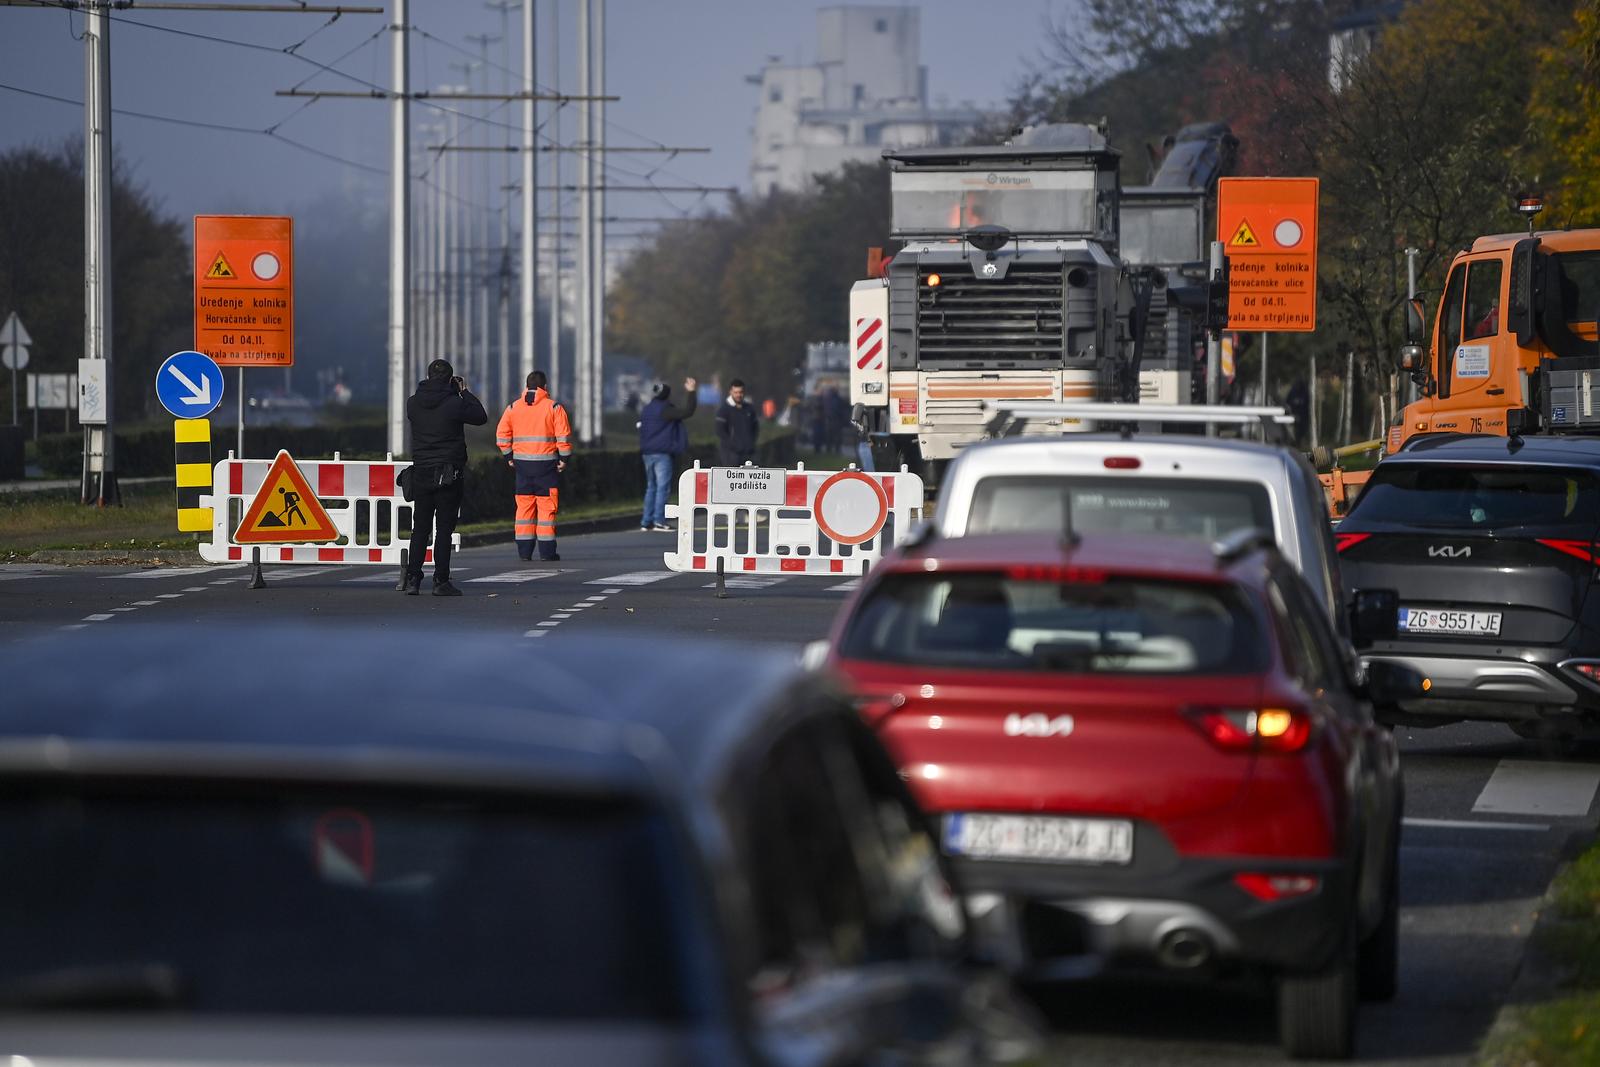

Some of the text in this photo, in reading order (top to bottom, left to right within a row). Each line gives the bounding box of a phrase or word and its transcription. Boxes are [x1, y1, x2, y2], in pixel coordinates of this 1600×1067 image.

[1275, 262, 1309, 272] kolnika
[1285, 278, 1304, 287] ulice
[253, 297, 287, 308] kolnika
[1244, 296, 1287, 306] Od 04.11.
[262, 315, 282, 324] ulice
[1264, 312, 1310, 324] strpljenju
[222, 335, 265, 345] Od 04.11.
[230, 351, 240, 359] na
[243, 350, 285, 361] strpljenju
[1470, 417, 1482, 433] 715
[726, 469, 771, 480] Osim vozila
[1428, 545, 1471, 557] KIA
[1408, 611, 1428, 628] ZG
